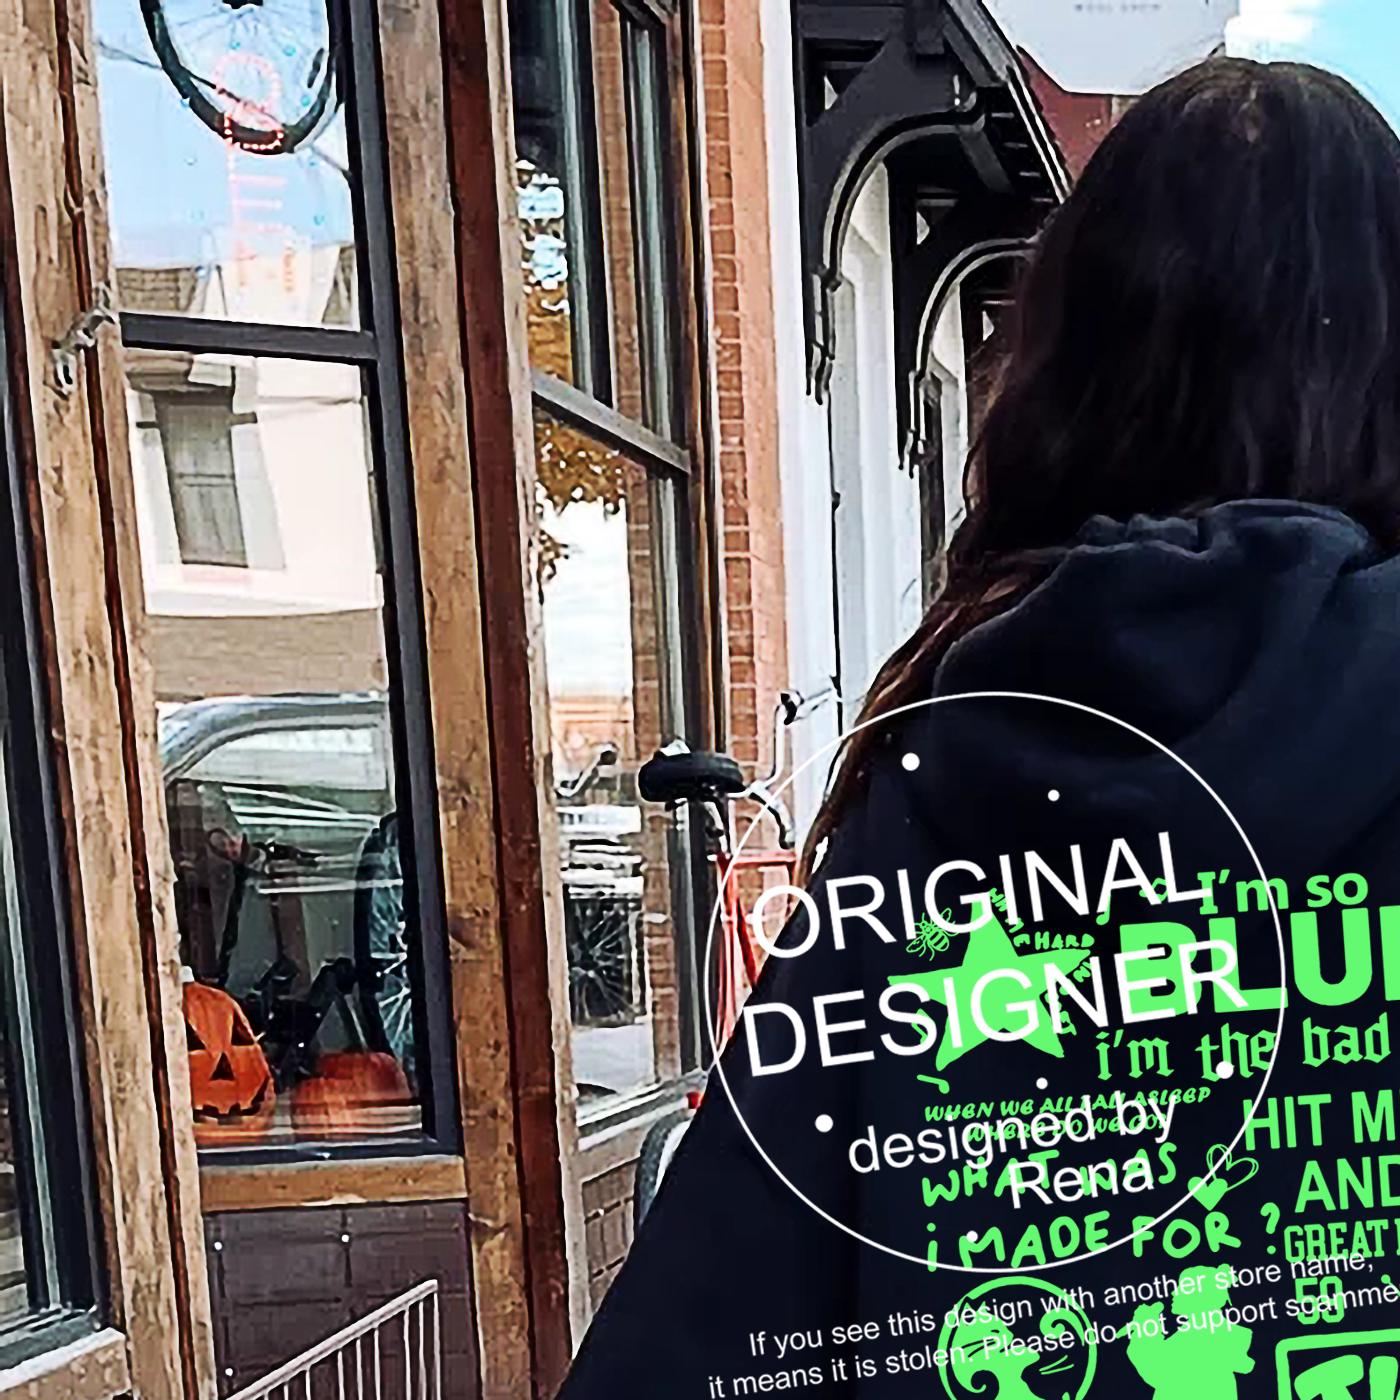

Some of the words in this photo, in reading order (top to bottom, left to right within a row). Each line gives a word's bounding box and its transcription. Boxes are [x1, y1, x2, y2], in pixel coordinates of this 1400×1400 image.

[1198, 868, 1290, 915] I'm
[1306, 872, 1369, 908] so
[1096, 1028, 1174, 1082] i'm
[1196, 1022, 1278, 1083] the
[1302, 1012, 1391, 1068] bad
[1242, 1093, 1333, 1152] HIT
[921, 1149, 1060, 1207] WHAT
[958, 1210, 1111, 1271] MADE
[1131, 1211, 1243, 1259] FOR
[1283, 1218, 1389, 1264] GREAT
